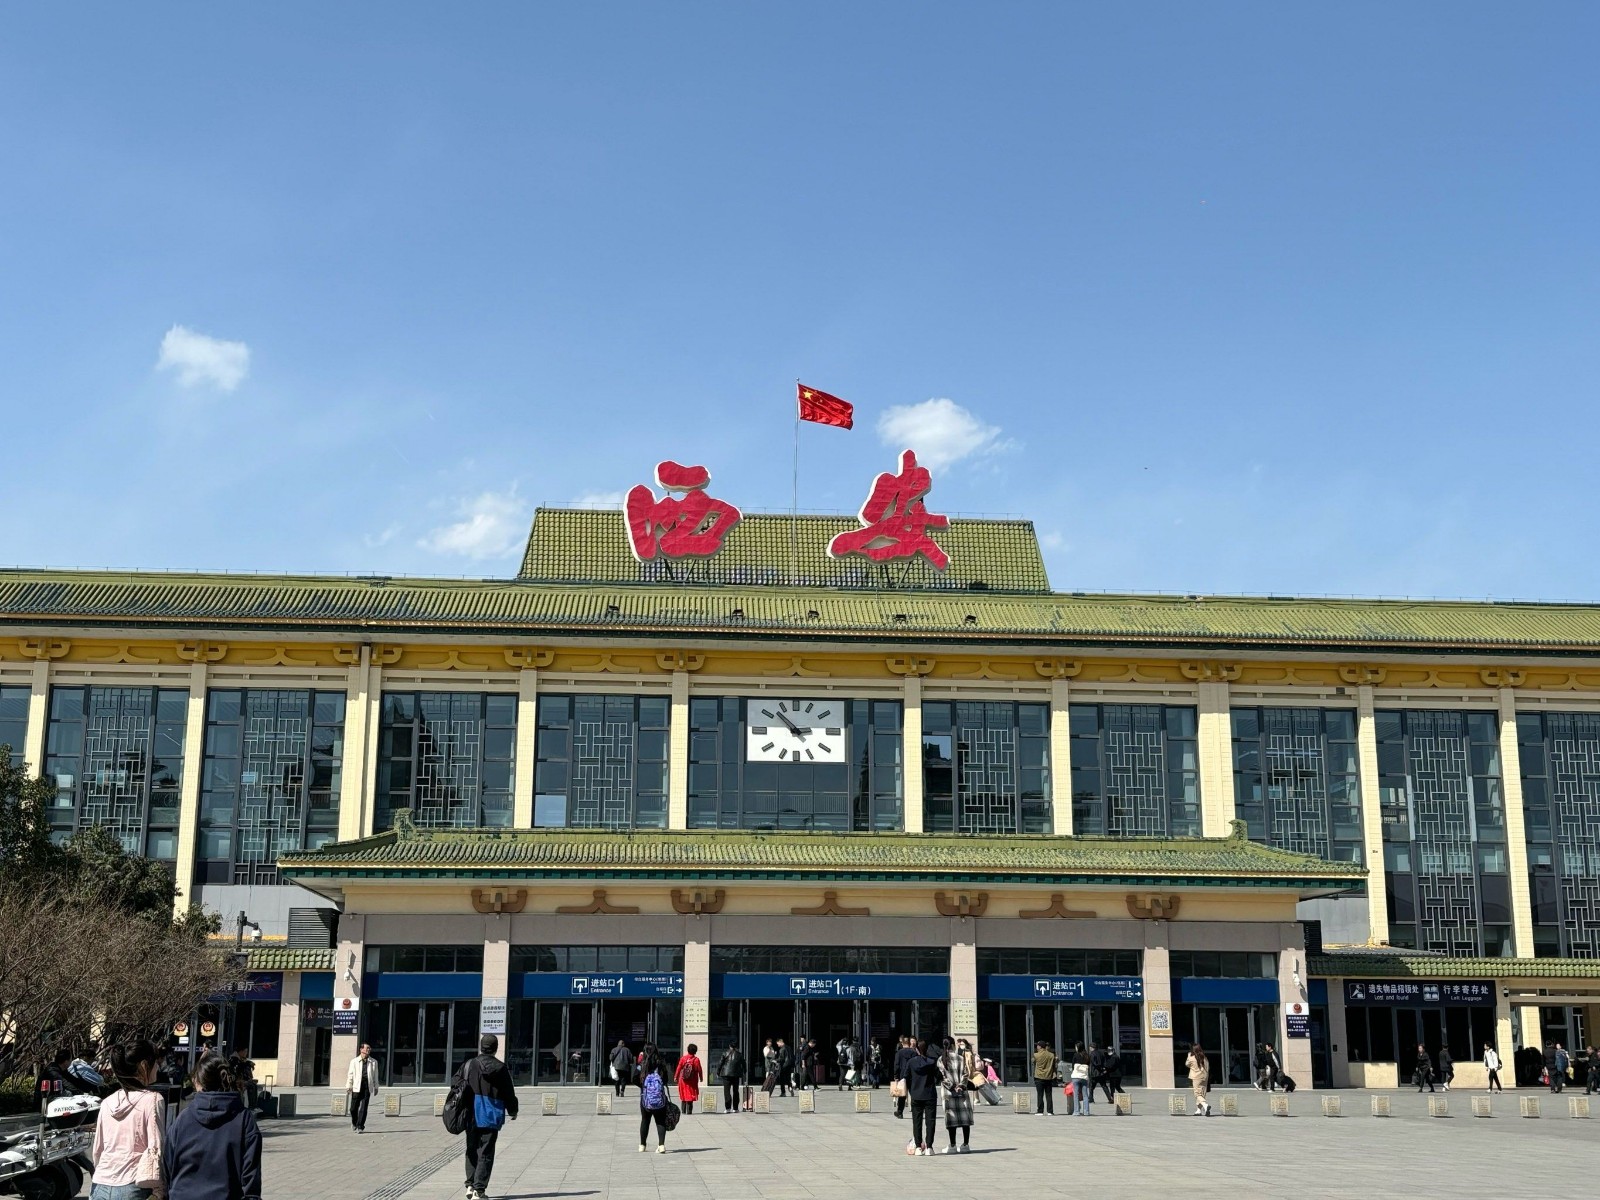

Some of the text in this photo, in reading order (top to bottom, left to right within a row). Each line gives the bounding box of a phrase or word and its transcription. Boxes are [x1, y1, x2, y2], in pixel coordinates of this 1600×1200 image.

[590, 977, 624, 994] 进站口 1
[808, 979, 833, 988] 进站口
[833, 978, 840, 995] 1
[1052, 980, 1084, 997] 进站口 1
[1368, 984, 1419, 994] 遗失物品招领处
[1443, 985, 1489, 995] 行李寄存处
